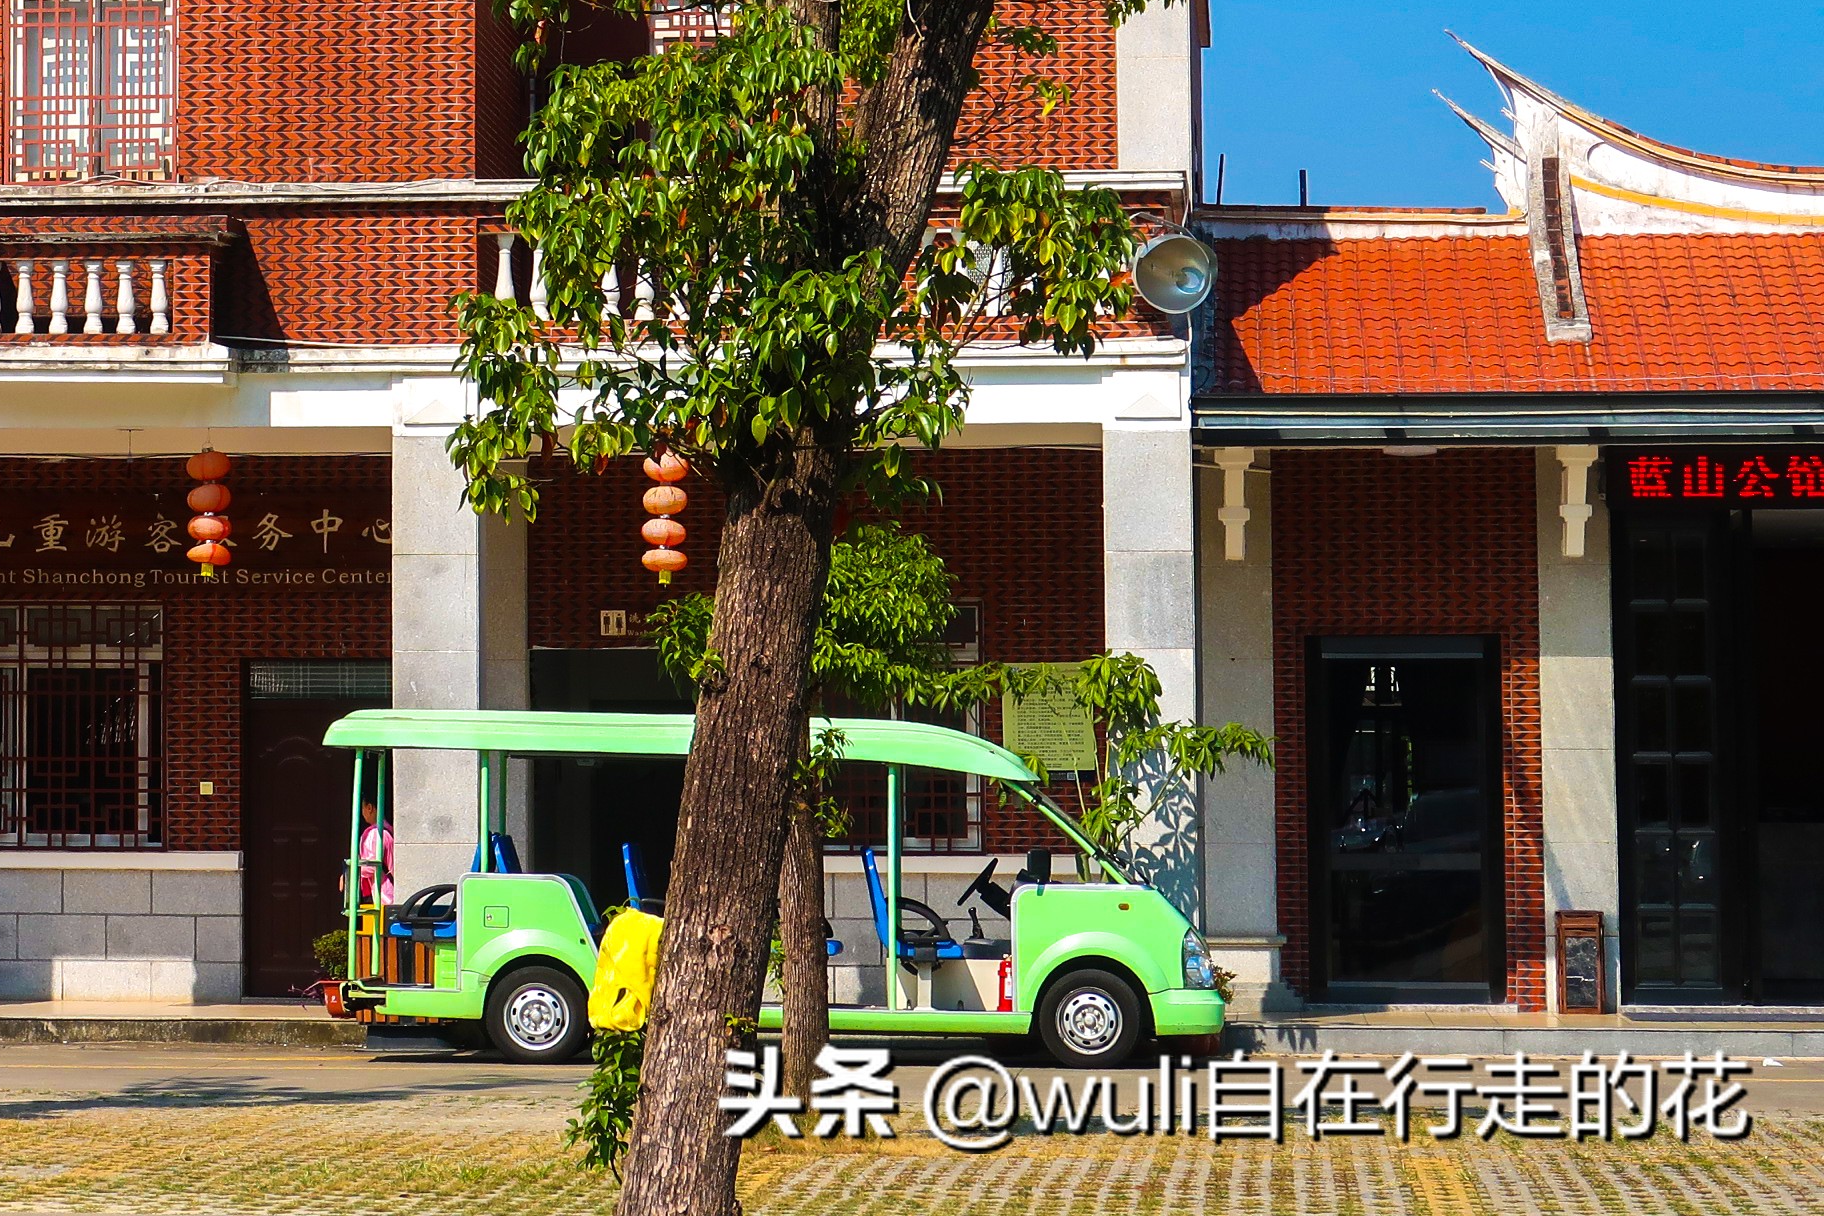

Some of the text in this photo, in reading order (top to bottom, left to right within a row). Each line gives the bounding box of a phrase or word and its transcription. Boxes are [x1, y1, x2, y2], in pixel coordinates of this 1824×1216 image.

[1628, 456, 1824, 497] 蓝山公馆
[22, 568, 146, 588] Shanchong
[236, 568, 316, 584] Service
